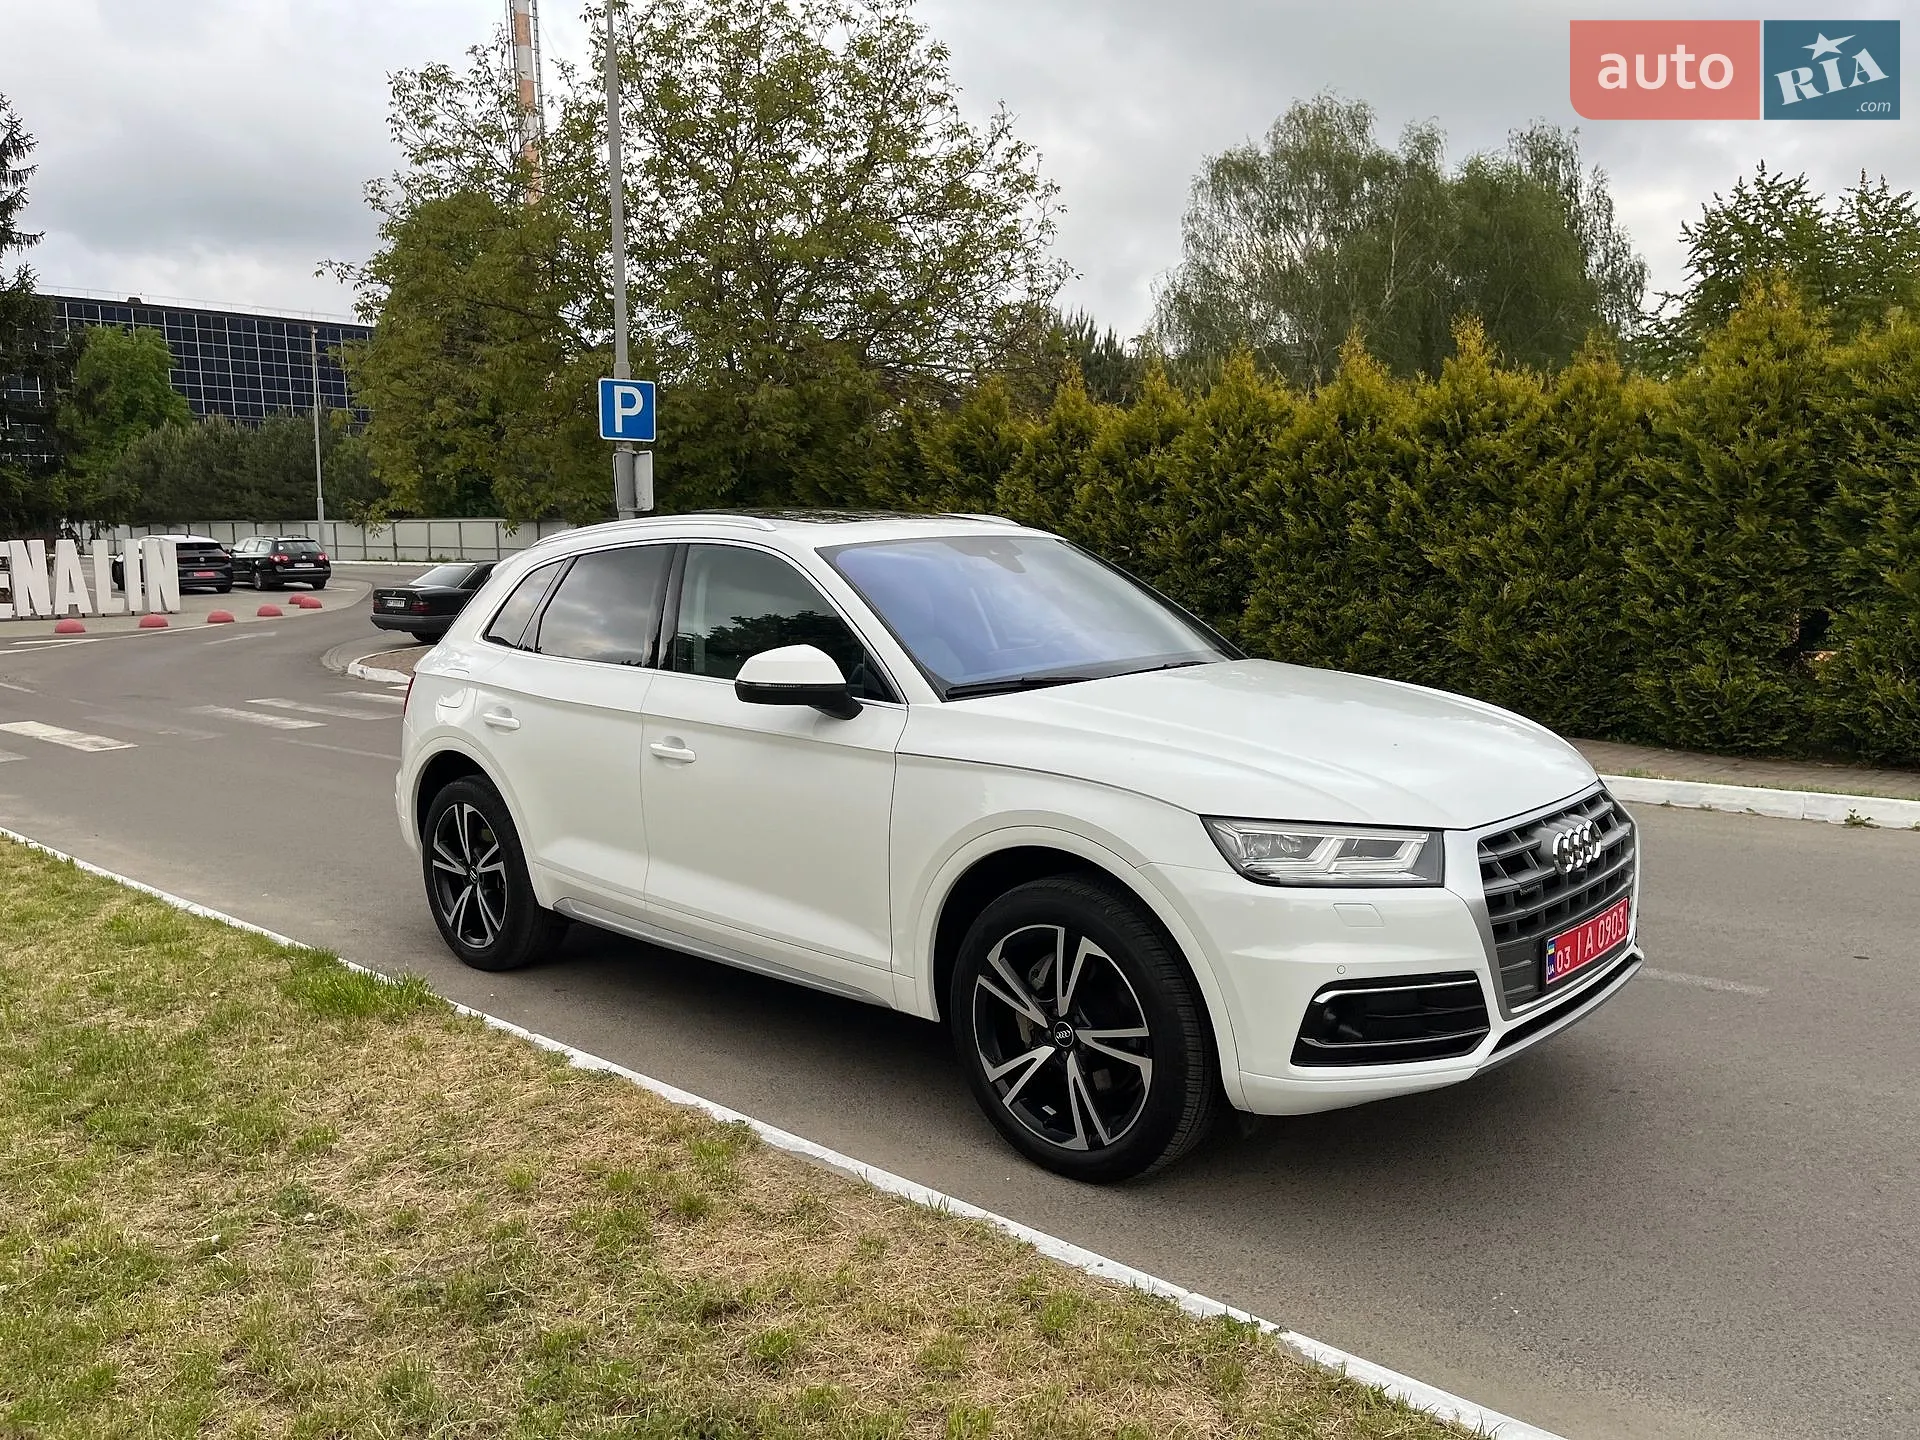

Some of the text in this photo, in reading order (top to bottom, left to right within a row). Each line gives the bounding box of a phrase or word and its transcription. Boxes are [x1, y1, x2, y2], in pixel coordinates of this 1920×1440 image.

[613, 385, 643, 432] P
[1556, 945, 1571, 973] 03
[1598, 907, 1624, 948] 0903
